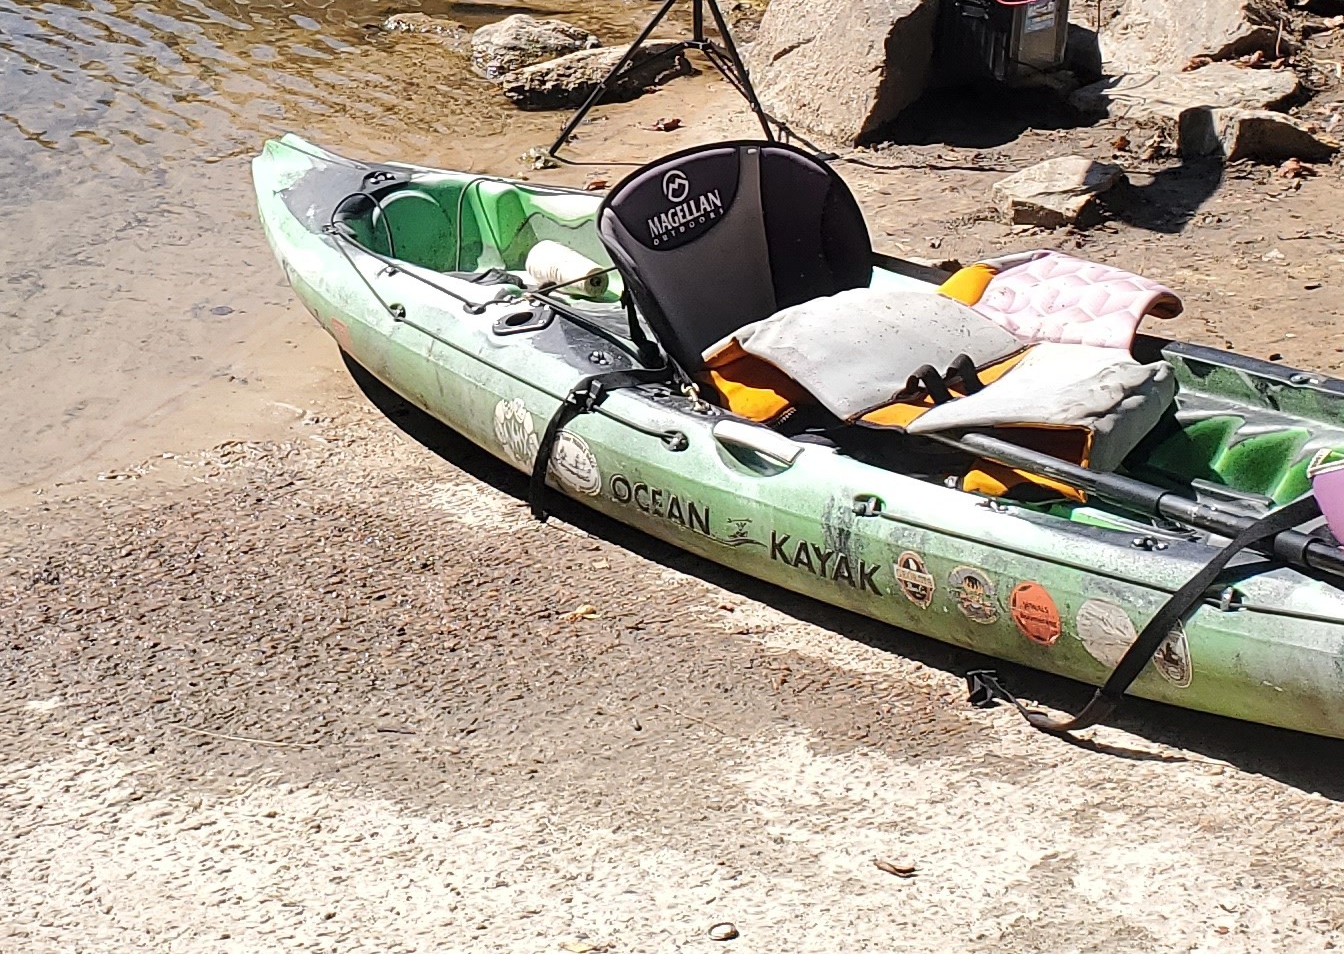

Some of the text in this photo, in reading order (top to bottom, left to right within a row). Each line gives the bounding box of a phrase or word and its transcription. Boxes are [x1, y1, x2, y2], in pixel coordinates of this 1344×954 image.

[648, 190, 721, 238] MAGELLAN
[654, 208, 724, 245] OUTDOORS
[610, 474, 711, 536] OCEAN
[770, 530, 884, 597] KAYAK
